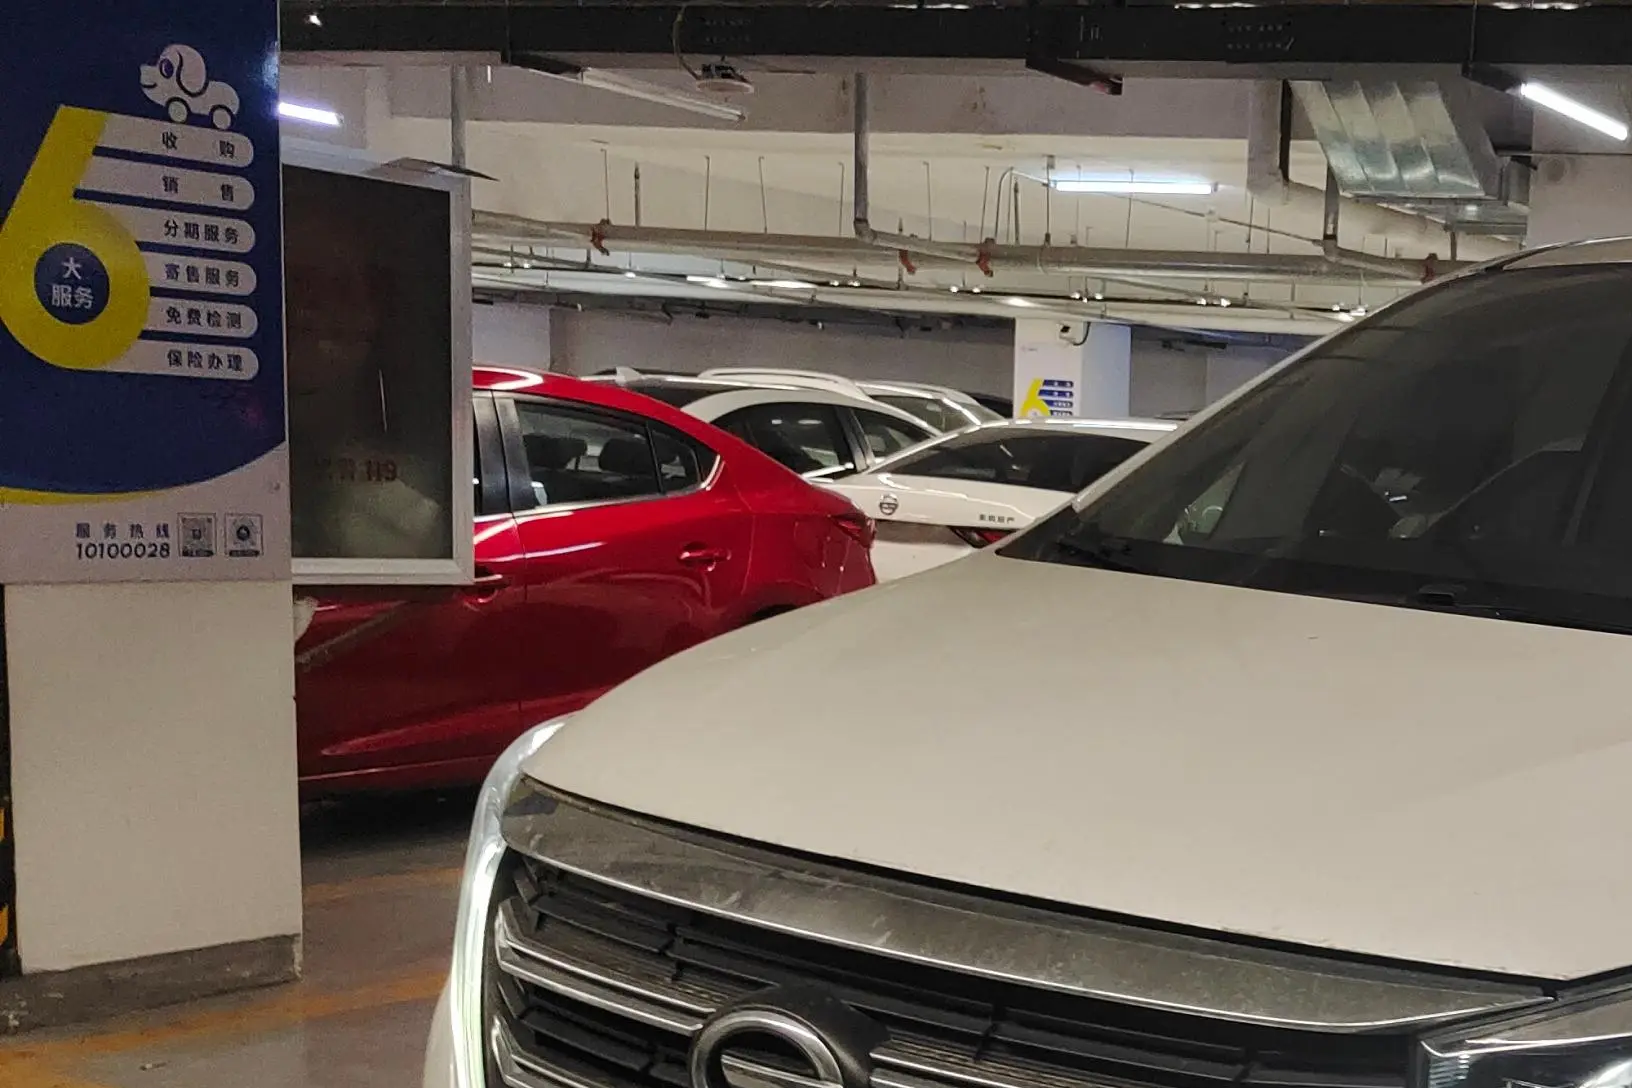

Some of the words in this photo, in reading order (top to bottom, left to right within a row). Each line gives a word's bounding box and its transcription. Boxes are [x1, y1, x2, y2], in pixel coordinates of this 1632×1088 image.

[162, 131, 235, 159] 收购
[162, 175, 234, 202] 销售
[164, 219, 239, 244] 分期服务
[62, 257, 82, 280] 大
[51, 284, 94, 309] 服务
[166, 306, 241, 328] 免费检测
[167, 350, 242, 371] 保险办理
[76, 523, 169, 539] 服务热线
[76, 543, 170, 560] 10100028
